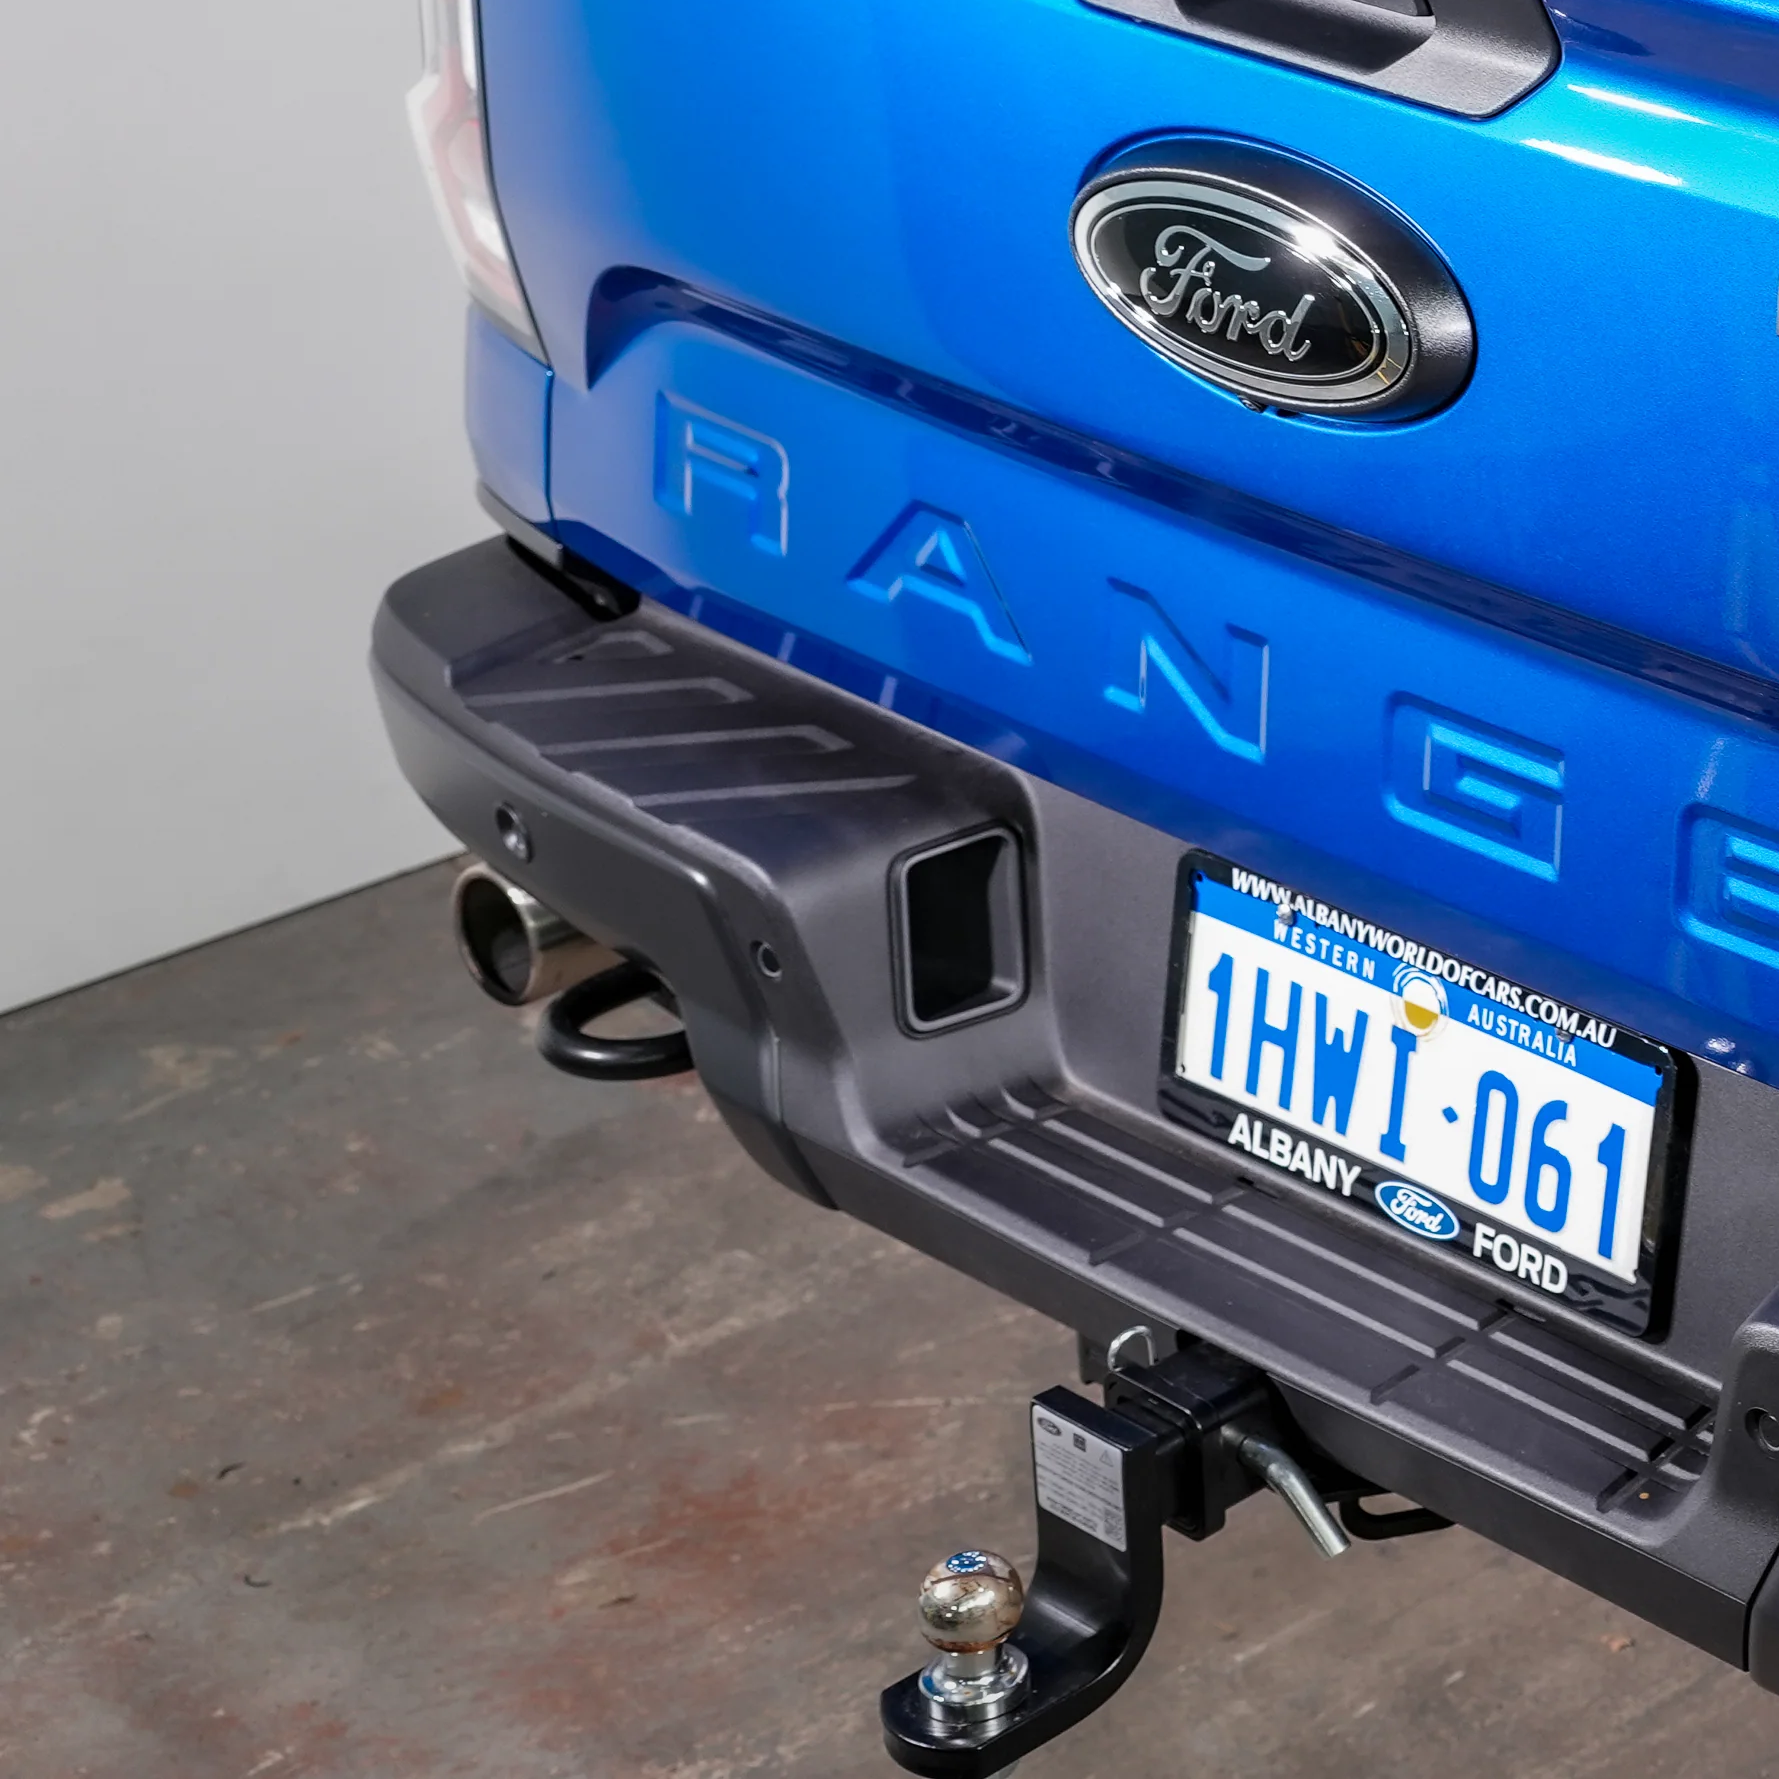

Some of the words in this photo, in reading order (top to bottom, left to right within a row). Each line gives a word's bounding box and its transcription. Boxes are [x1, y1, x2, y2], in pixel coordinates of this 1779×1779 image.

[1139, 223, 1315, 362] Ford
[1231, 867, 1618, 1049] WWW.ALBANYWORLDOFCARS.COM.AU
[1273, 919, 1376, 981] WESTERN
[1467, 1003, 1577, 1068] AUSTRALIA
[1227, 1113, 1362, 1197] ALBANY
[1389, 1188, 1445, 1233] Ford
[1472, 1223, 1568, 1297] FORD
